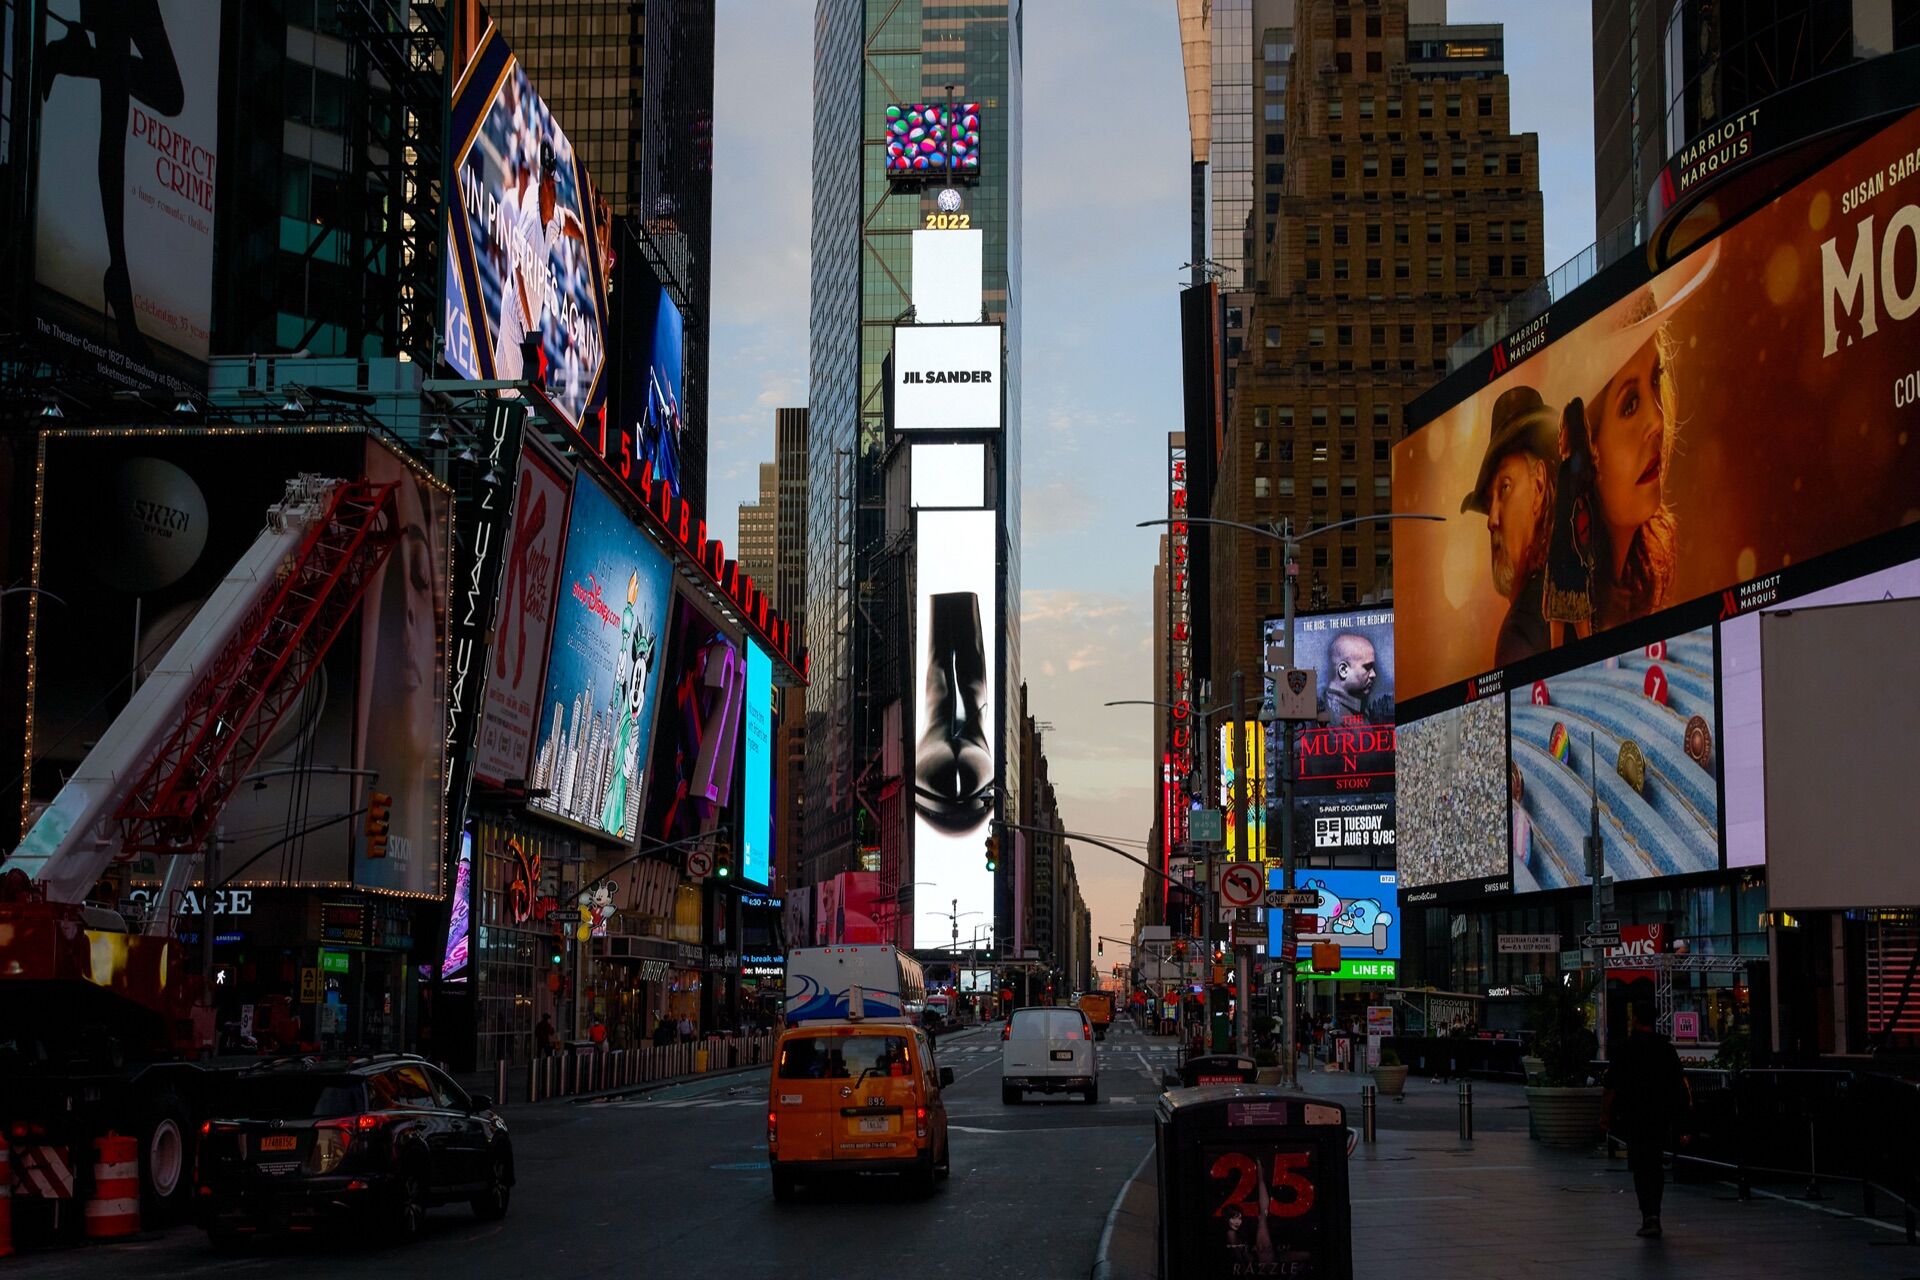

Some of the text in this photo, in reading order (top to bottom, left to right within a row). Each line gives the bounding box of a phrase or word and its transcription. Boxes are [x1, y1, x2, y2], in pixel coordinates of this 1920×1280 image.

[132, 108, 215, 181] PERFECT
[1681, 109, 1760, 169] MARRIOTT
[1681, 138, 1748, 191] MARQUIS
[156, 157, 212, 212] CRIME
[1842, 170, 1884, 215] SUSAN
[157, 200, 186, 224] romantic
[188, 211, 210, 236] thriller
[926, 214, 970, 230] 2022
[465, 163, 600, 370] IN PINSTRIPES AGAIN
[1509, 312, 1550, 348] MARRIOTT
[36, 317, 51, 335] The
[52, 323, 81, 348] Theater
[82, 337, 107, 359] Center
[108, 348, 124, 367] 1627
[125, 356, 158, 384] Broadway
[1510, 331, 1545, 363] MARQUIS
[903, 370, 993, 384] JIL SANDER
[135, 498, 191, 533] SKKN
[1173, 461, 1188, 593] ERNST
[679, 498, 791, 660] BROADWAY
[1740, 574, 1781, 597] MARRIOTT
[1740, 589, 1777, 609] MARQUIS
[1303, 621, 1313, 631] THE
[1313, 620, 1327, 631] RISE.
[1329, 618, 1339, 629] THE
[1340, 618, 1354, 628] FALL.
[1356, 616, 1366, 627] THE
[1478, 671, 1504, 685] MARRIOTT
[1478, 682, 1501, 696] MARQUIS
[1343, 714, 1364, 724] THE
[1335, 777, 1372, 790] STORY
[1341, 803, 1389, 812] DOCUMENTARY
[1343, 815, 1383, 832] TUESDAY
[1343, 830, 1395, 846] AUG 9 9/8C
[1484, 882, 1499, 893] SWISS
[1268, 894, 1311, 903] ONE WAY
[1352, 964, 1395, 976] LINE FR
[1488, 986, 1507, 998] swatch
[1430, 998, 1470, 1008] DISCOVER
[868, 1097, 885, 1106] 892
[1209, 1151, 1318, 1219] 25
[1232, 1262, 1300, 1277] RAZZLE
